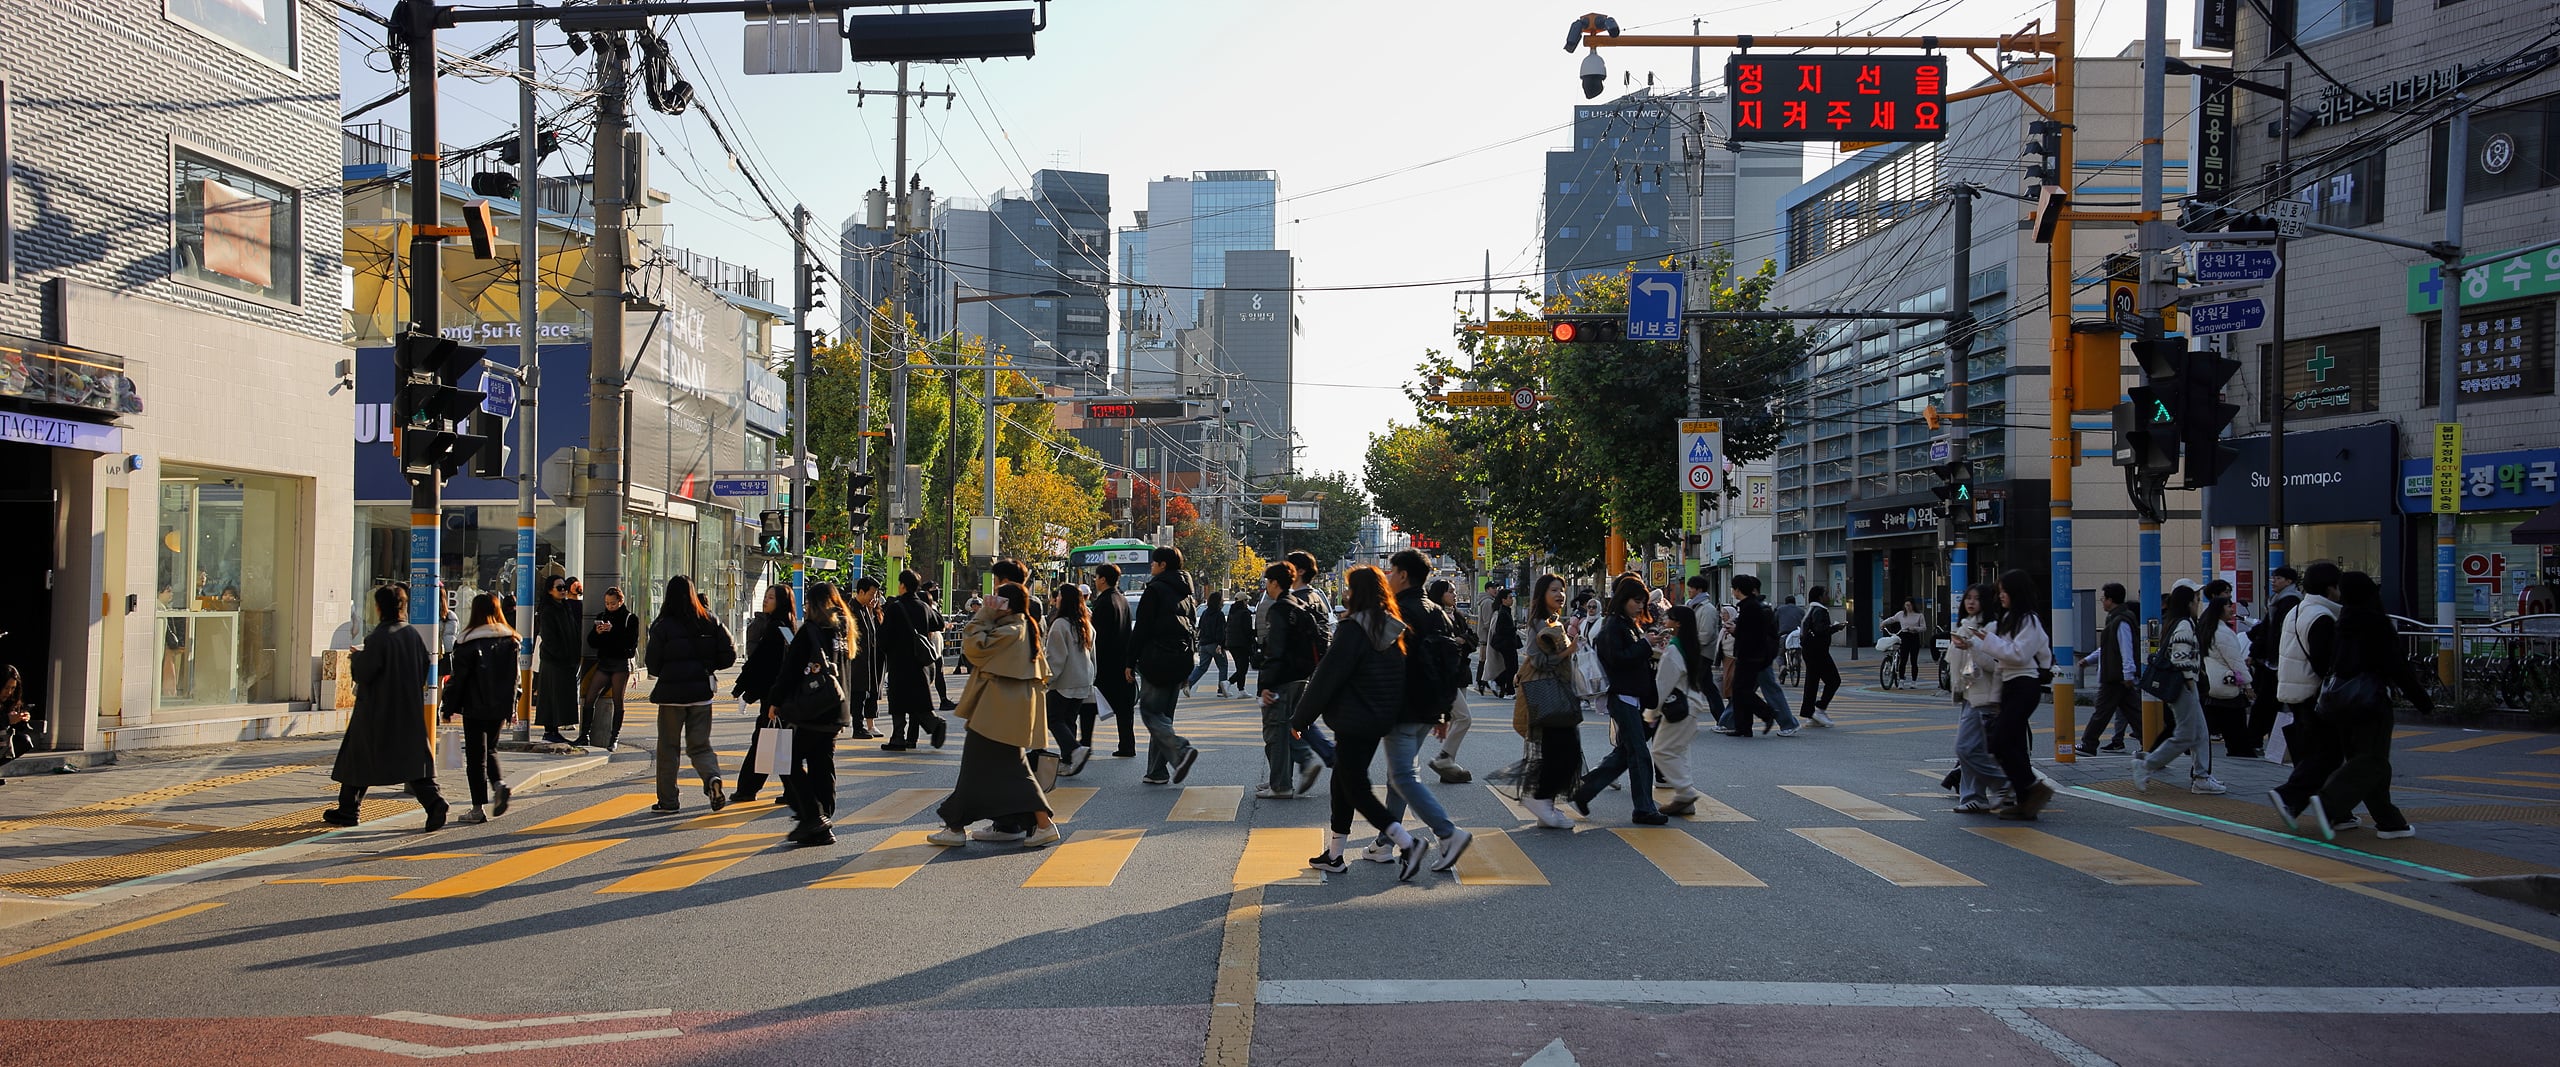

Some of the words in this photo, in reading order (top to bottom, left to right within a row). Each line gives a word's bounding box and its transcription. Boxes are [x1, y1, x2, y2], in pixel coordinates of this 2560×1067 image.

[1737, 100, 1940, 131] 지켜주세요
[2278, 219, 2305, 235] 전금지
[2201, 253, 2246, 268] 상원1길
[2201, 270, 2241, 279] Sangwon
[2243, 269, 2264, 278] 1-gil
[1239, 313, 1274, 321] 동일빌딩
[2194, 304, 2229, 322] 상원길
[505, 322, 570, 338] Teace
[1630, 320, 1677, 337] 비보호
[2194, 320, 2246, 334] Sangwon-gil
[2461, 335, 2522, 357] 정형외과
[660, 338, 706, 401] FRIDAY
[2461, 354, 2522, 374] 비뇨기과
[1517, 393, 1532, 404] 30
[2292, 385, 2350, 411] 성수의원
[2442, 426, 2454, 463] 불법주정차
[740, 481, 767, 489] 연무장길
[1693, 472, 1709, 482] 30
[2251, 471, 2288, 488] Stuo
[2291, 471, 2342, 488] mmap.c
[1752, 482, 1765, 494] 3F
[2440, 472, 2453, 510] 무인단속중
[1752, 496, 1765, 508] 2F
[2462, 553, 2506, 595] 약
